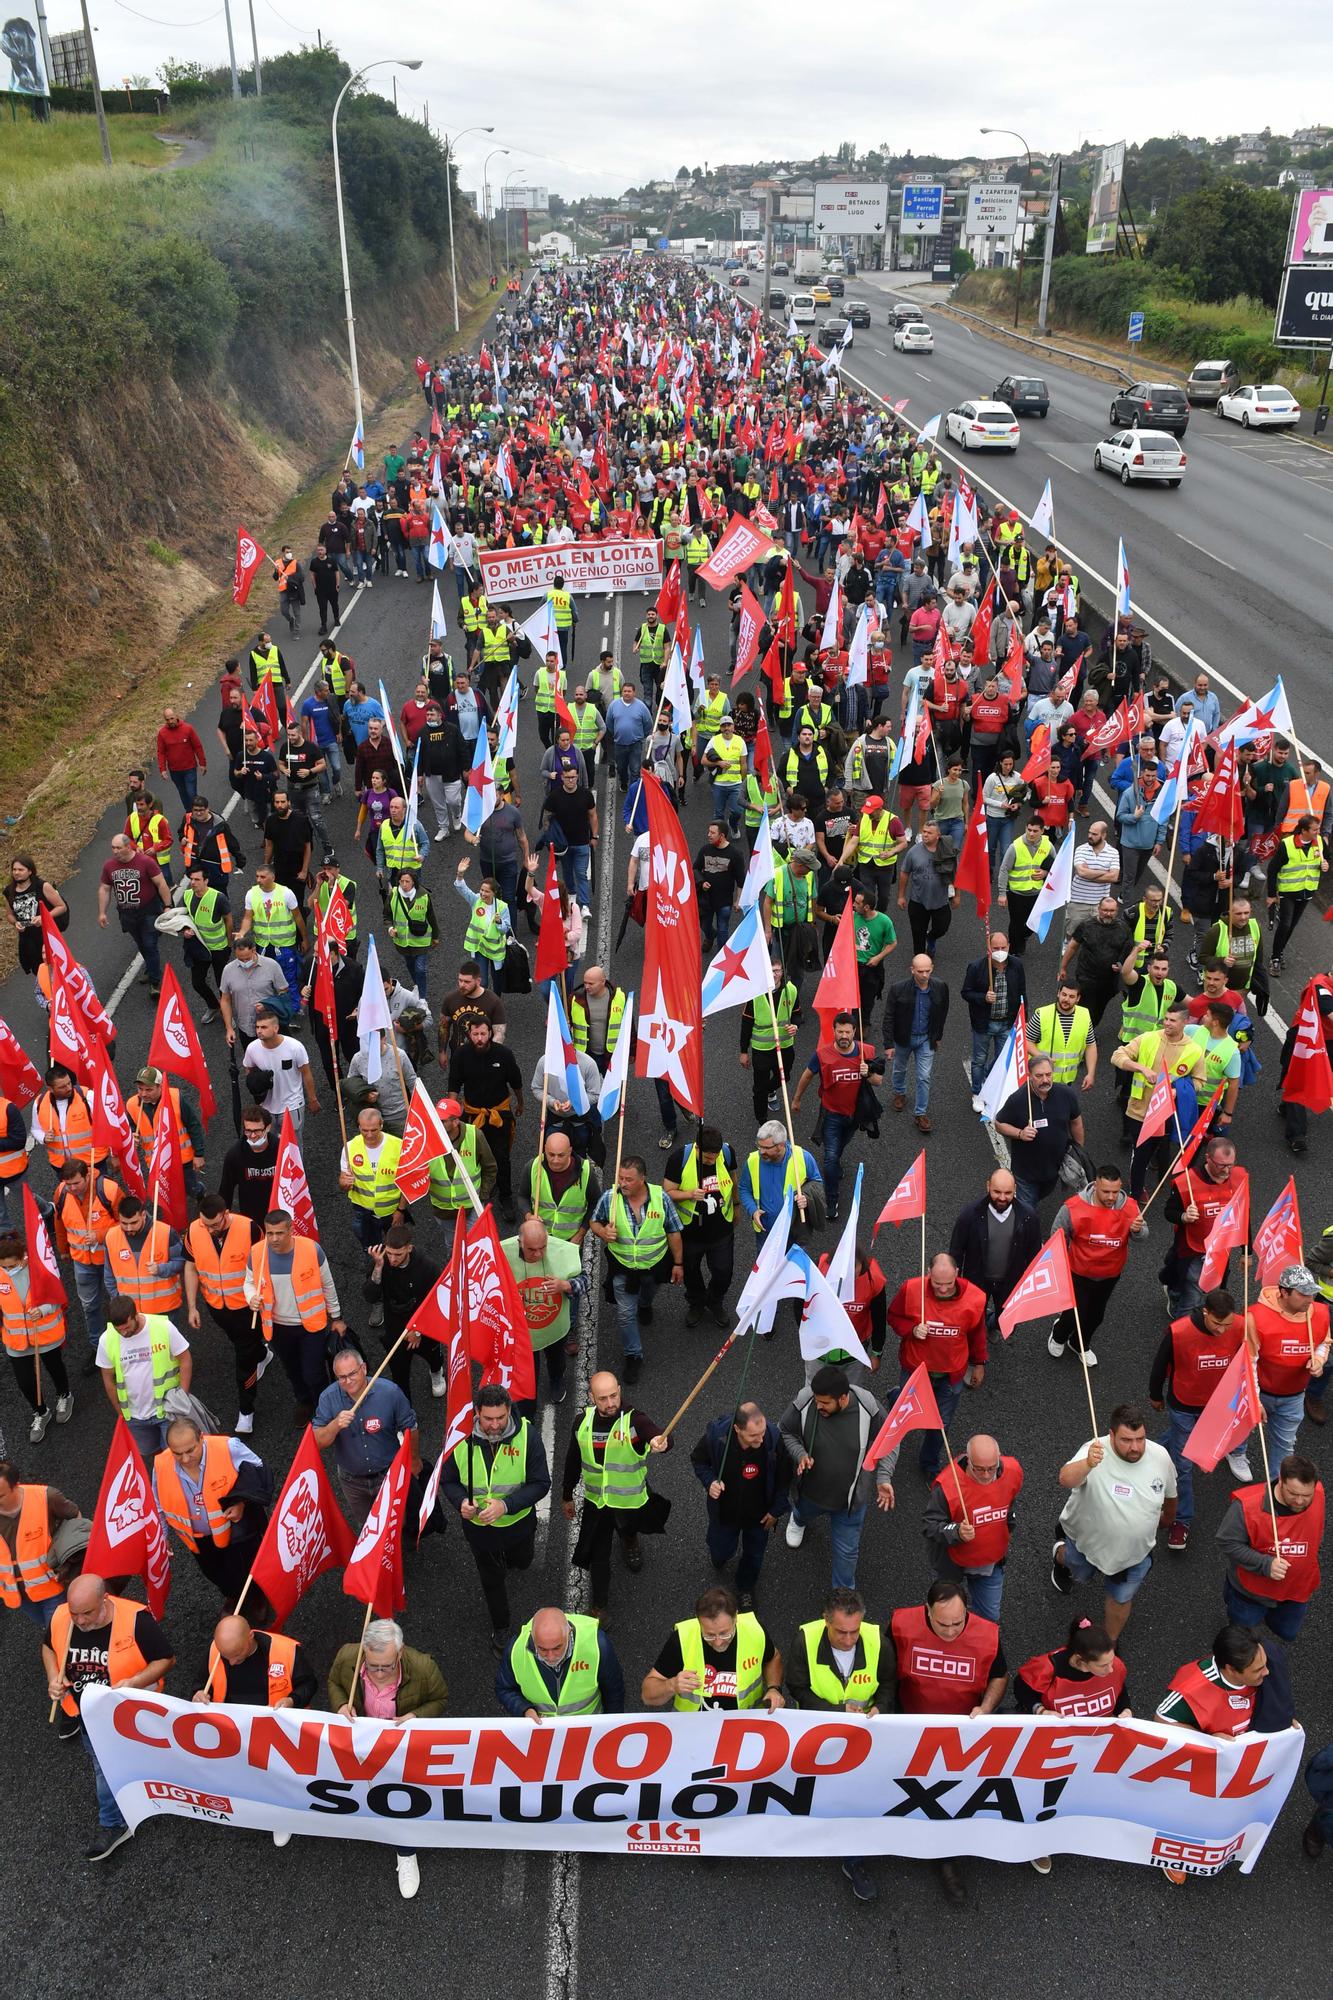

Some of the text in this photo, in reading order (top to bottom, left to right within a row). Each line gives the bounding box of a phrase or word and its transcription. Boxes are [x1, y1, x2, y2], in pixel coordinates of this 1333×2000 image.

[913, 196, 939, 204] Santiago
[925, 212, 939, 220] Lugo
[1311, 313, 1319, 321] EL
[488, 546, 654, 578] O METAL EN LOITA
[490, 561, 655, 591] POR UN CONVENIO DIGNO
[112, 869, 141, 881] TIGERS
[18, 1082, 36, 1099] Agro
[929, 1326, 959, 1336] CCOO
[570, 1660, 590, 1673] CIG
[742, 1656, 759, 1671] CIG
[915, 1655, 971, 1677] CCOO
[81, 1672, 98, 1682] no
[852, 1673, 872, 1685] CIG
[1059, 1694, 1112, 1717] CCOO
[112, 1698, 1276, 1799] CONVENIO DO METAL
[149, 1783, 201, 1805] UGT
[307, 1765, 1068, 1824] SOLUCIÓN XA!
[192, 1805, 231, 1822] FICA
[626, 1821, 701, 1842] CIG
[629, 1843, 700, 1853] INDUSTRIA
[1159, 1839, 1239, 1863] CCOO
